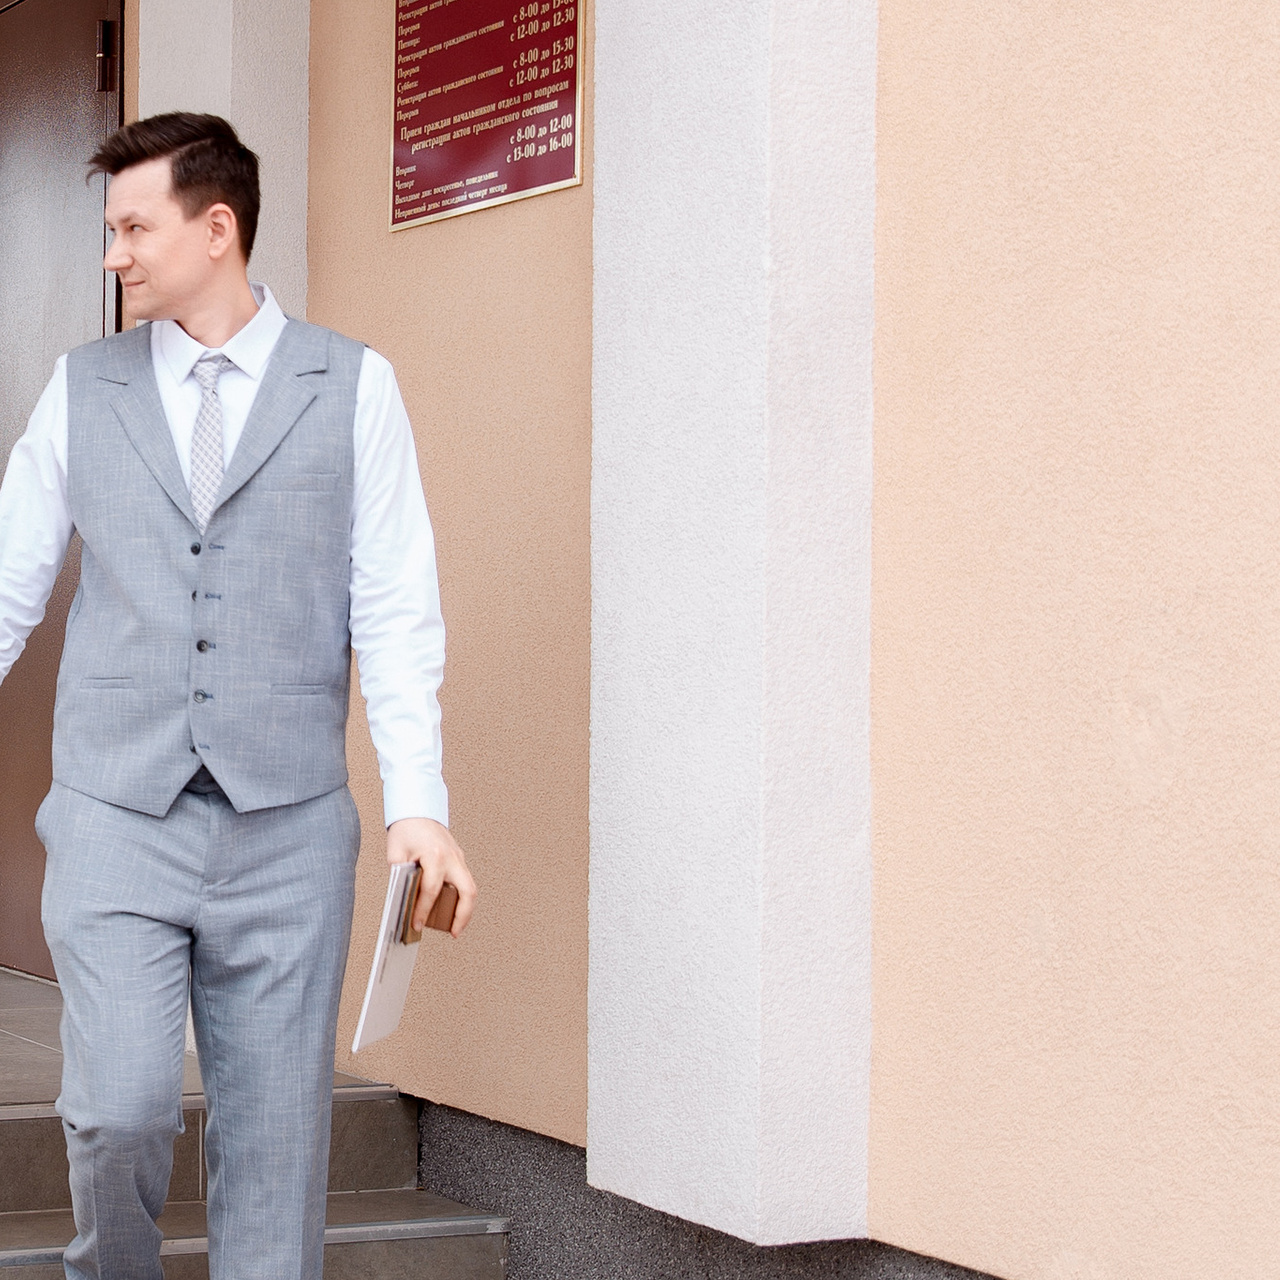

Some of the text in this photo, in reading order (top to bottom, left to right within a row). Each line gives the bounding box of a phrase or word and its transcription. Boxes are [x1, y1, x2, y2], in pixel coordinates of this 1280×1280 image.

[429, 0, 442, 10] актов
[429, 44, 442, 53] актов
[444, 31, 477, 50] гражданского
[479, 20, 504, 35] состояния
[513, 15, 517, 23] с
[541, 3, 549, 14] до
[398, 23, 420, 36] Перерыв
[398, 66, 420, 79] Перерыв
[510, 34, 514, 42] с
[541, 21, 550, 32] до
[397, 109, 419, 121] Перерыв
[510, 79, 513, 87] с
[540, 68, 549, 79] до
[398, 81, 418, 94] Суббота:
[428, 87, 441, 97] актов
[443, 75, 476, 93] гражданского
[478, 66, 503, 80] состояния
[513, 60, 517, 68] с
[541, 49, 549, 60] до
[401, 80, 568, 142] Прием граждан начальником отдела по вопросам
[412, 100, 558, 154] регистрации актов гражданского состояния
[395, 180, 414, 190] Четверг
[507, 155, 511, 163] с
[537, 145, 546, 156] до
[396, 165, 416, 176] Вторник
[510, 136, 514, 144] с
[538, 126, 547, 138] до
[442, 191, 467, 206] последний
[468, 188, 487, 198] четверг
[489, 183, 507, 193] месяца
[466, 171, 498, 185] понедельник
